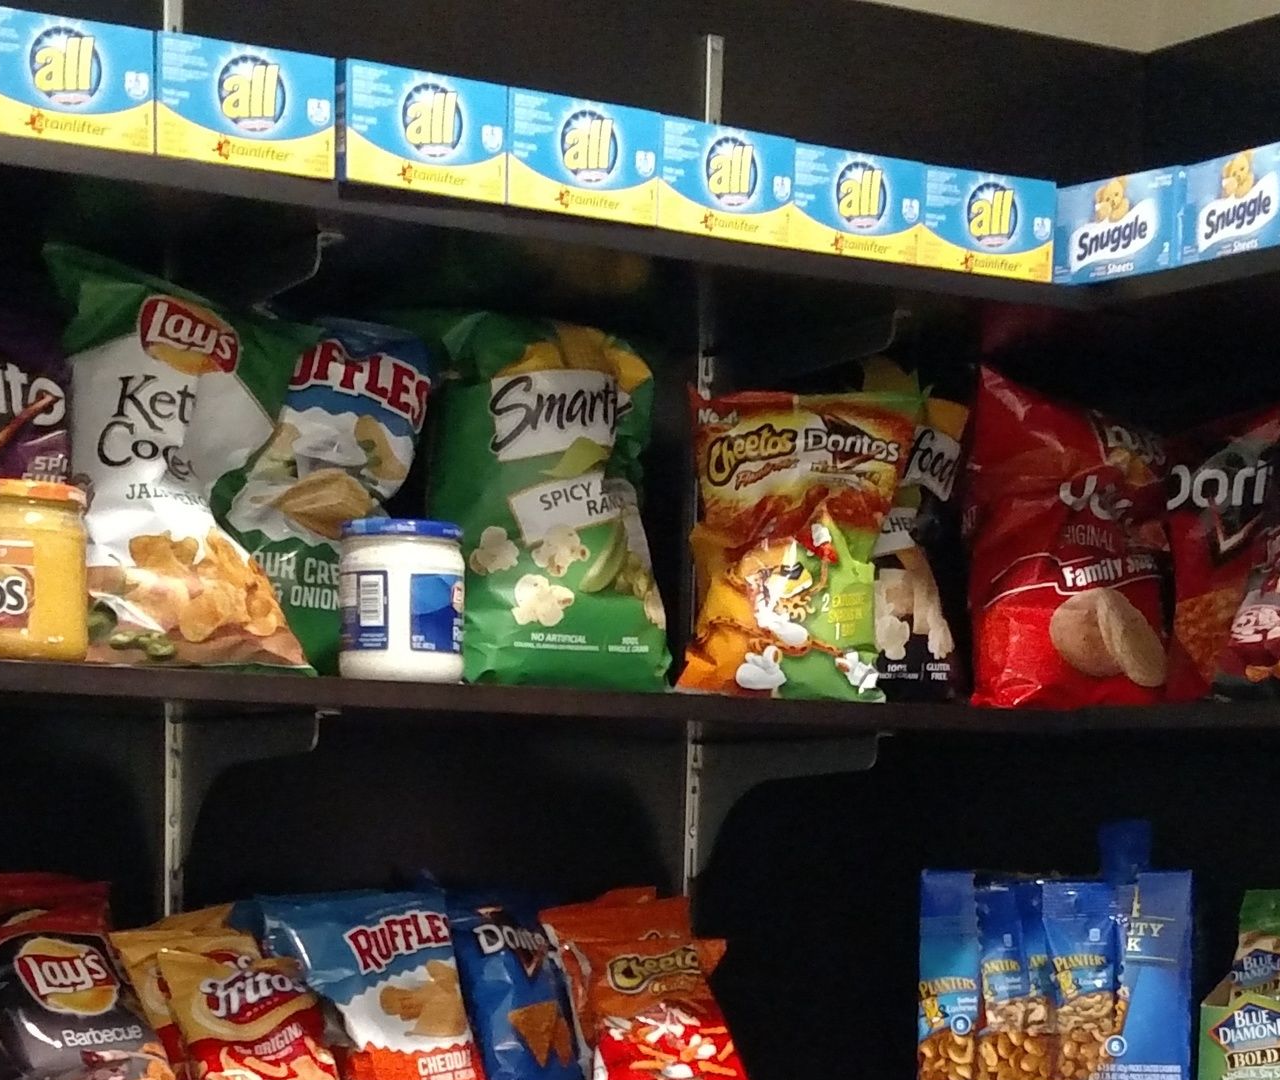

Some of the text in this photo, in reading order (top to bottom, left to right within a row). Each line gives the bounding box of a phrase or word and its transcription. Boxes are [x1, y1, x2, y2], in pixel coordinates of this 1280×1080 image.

[35, 35, 95, 96] all
[221, 63, 279, 120] all
[404, 90, 458, 147] all
[564, 116, 614, 171] all
[707, 143, 754, 197] all
[839, 168, 882, 217] all
[968, 187, 1015, 238] all
[1204, 191, 1272, 240] Snuggle
[1077, 217, 1149, 263] Snuggle
[706, 423, 799, 488] Cheetos
[804, 428, 901, 463] Doritos
[538, 482, 593, 513] SPICY
[1062, 557, 1123, 588] Family
[23, 949, 109, 996] Lay's
[920, 976, 977, 999] PLANTERS
[1052, 954, 1108, 973] PLANTERS
[61, 1023, 145, 1048] Barbecue
[1233, 1010, 1272, 1028] BLUE
[1232, 1047, 1280, 1067] BOLD
